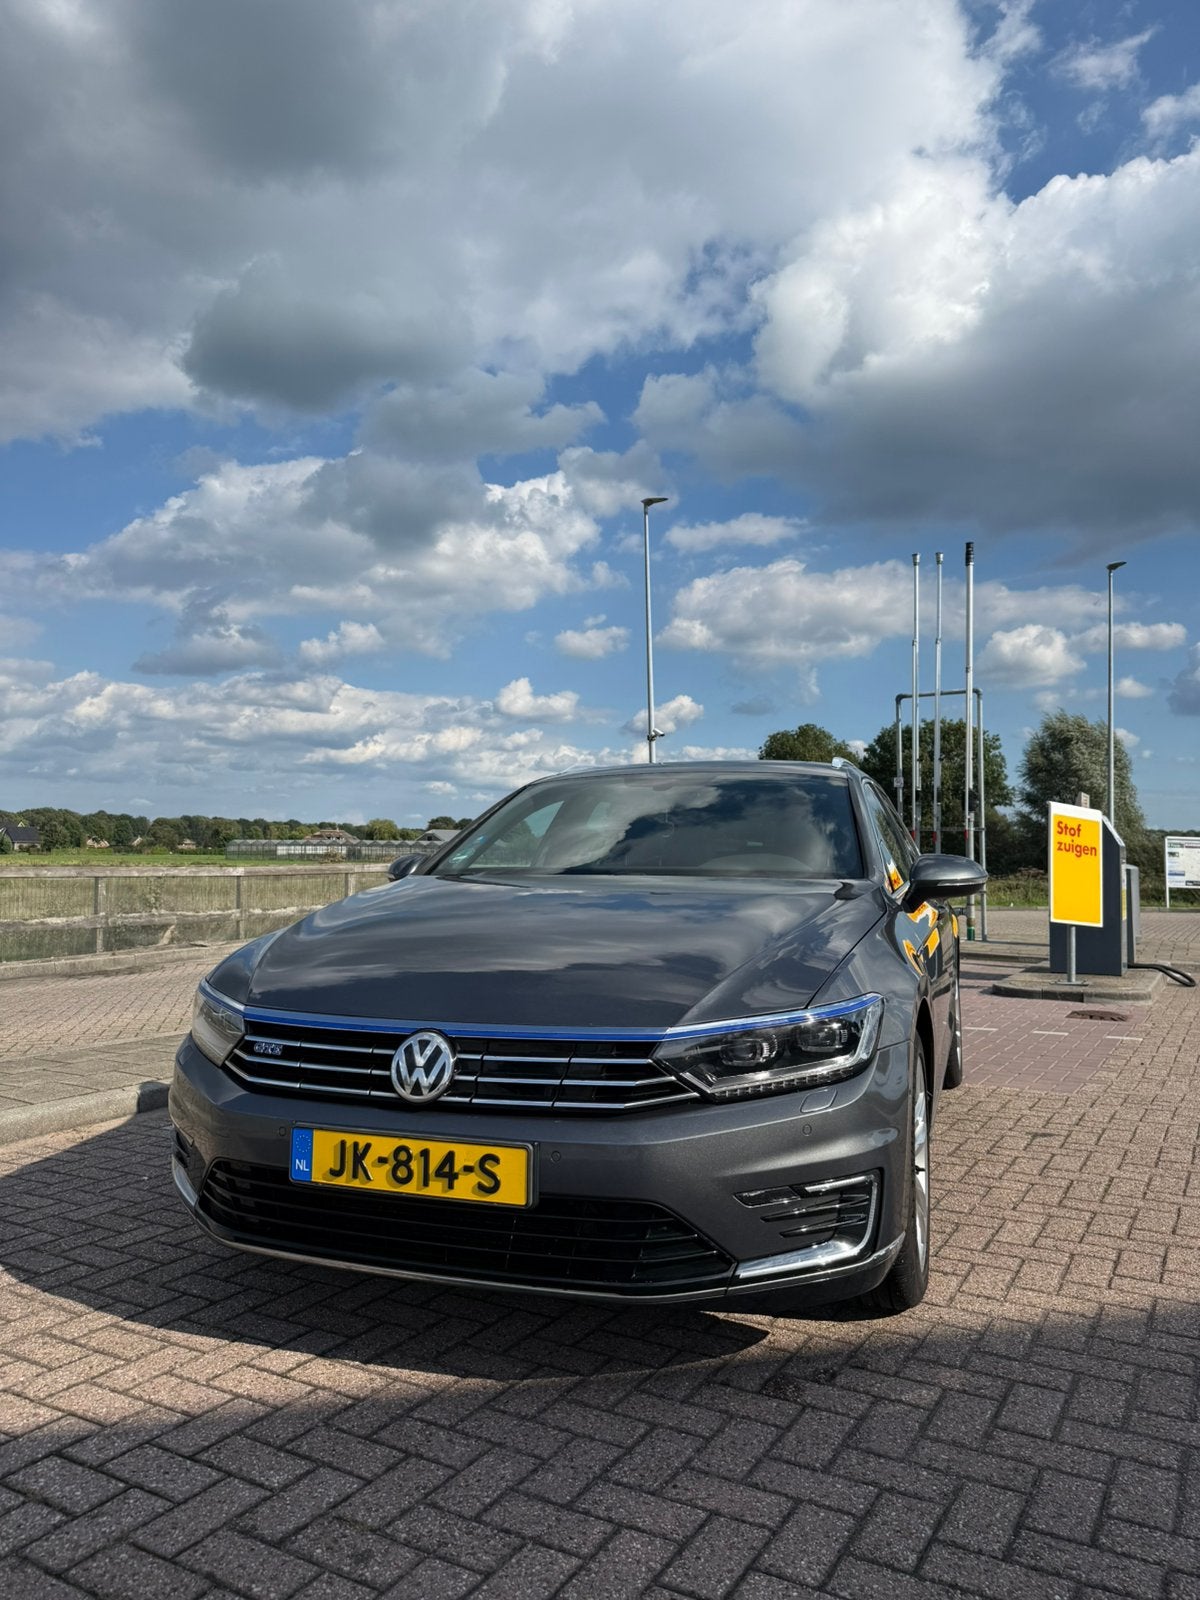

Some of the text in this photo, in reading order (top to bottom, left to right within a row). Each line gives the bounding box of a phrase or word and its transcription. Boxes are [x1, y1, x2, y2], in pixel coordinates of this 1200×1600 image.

[1056, 821, 1082, 838] Stof
[1056, 839, 1097, 858] zuigen
[392, 1032, 454, 1101] VW
[295, 1159, 309, 1172] NL
[329, 1139, 501, 1194] JK-814-S
